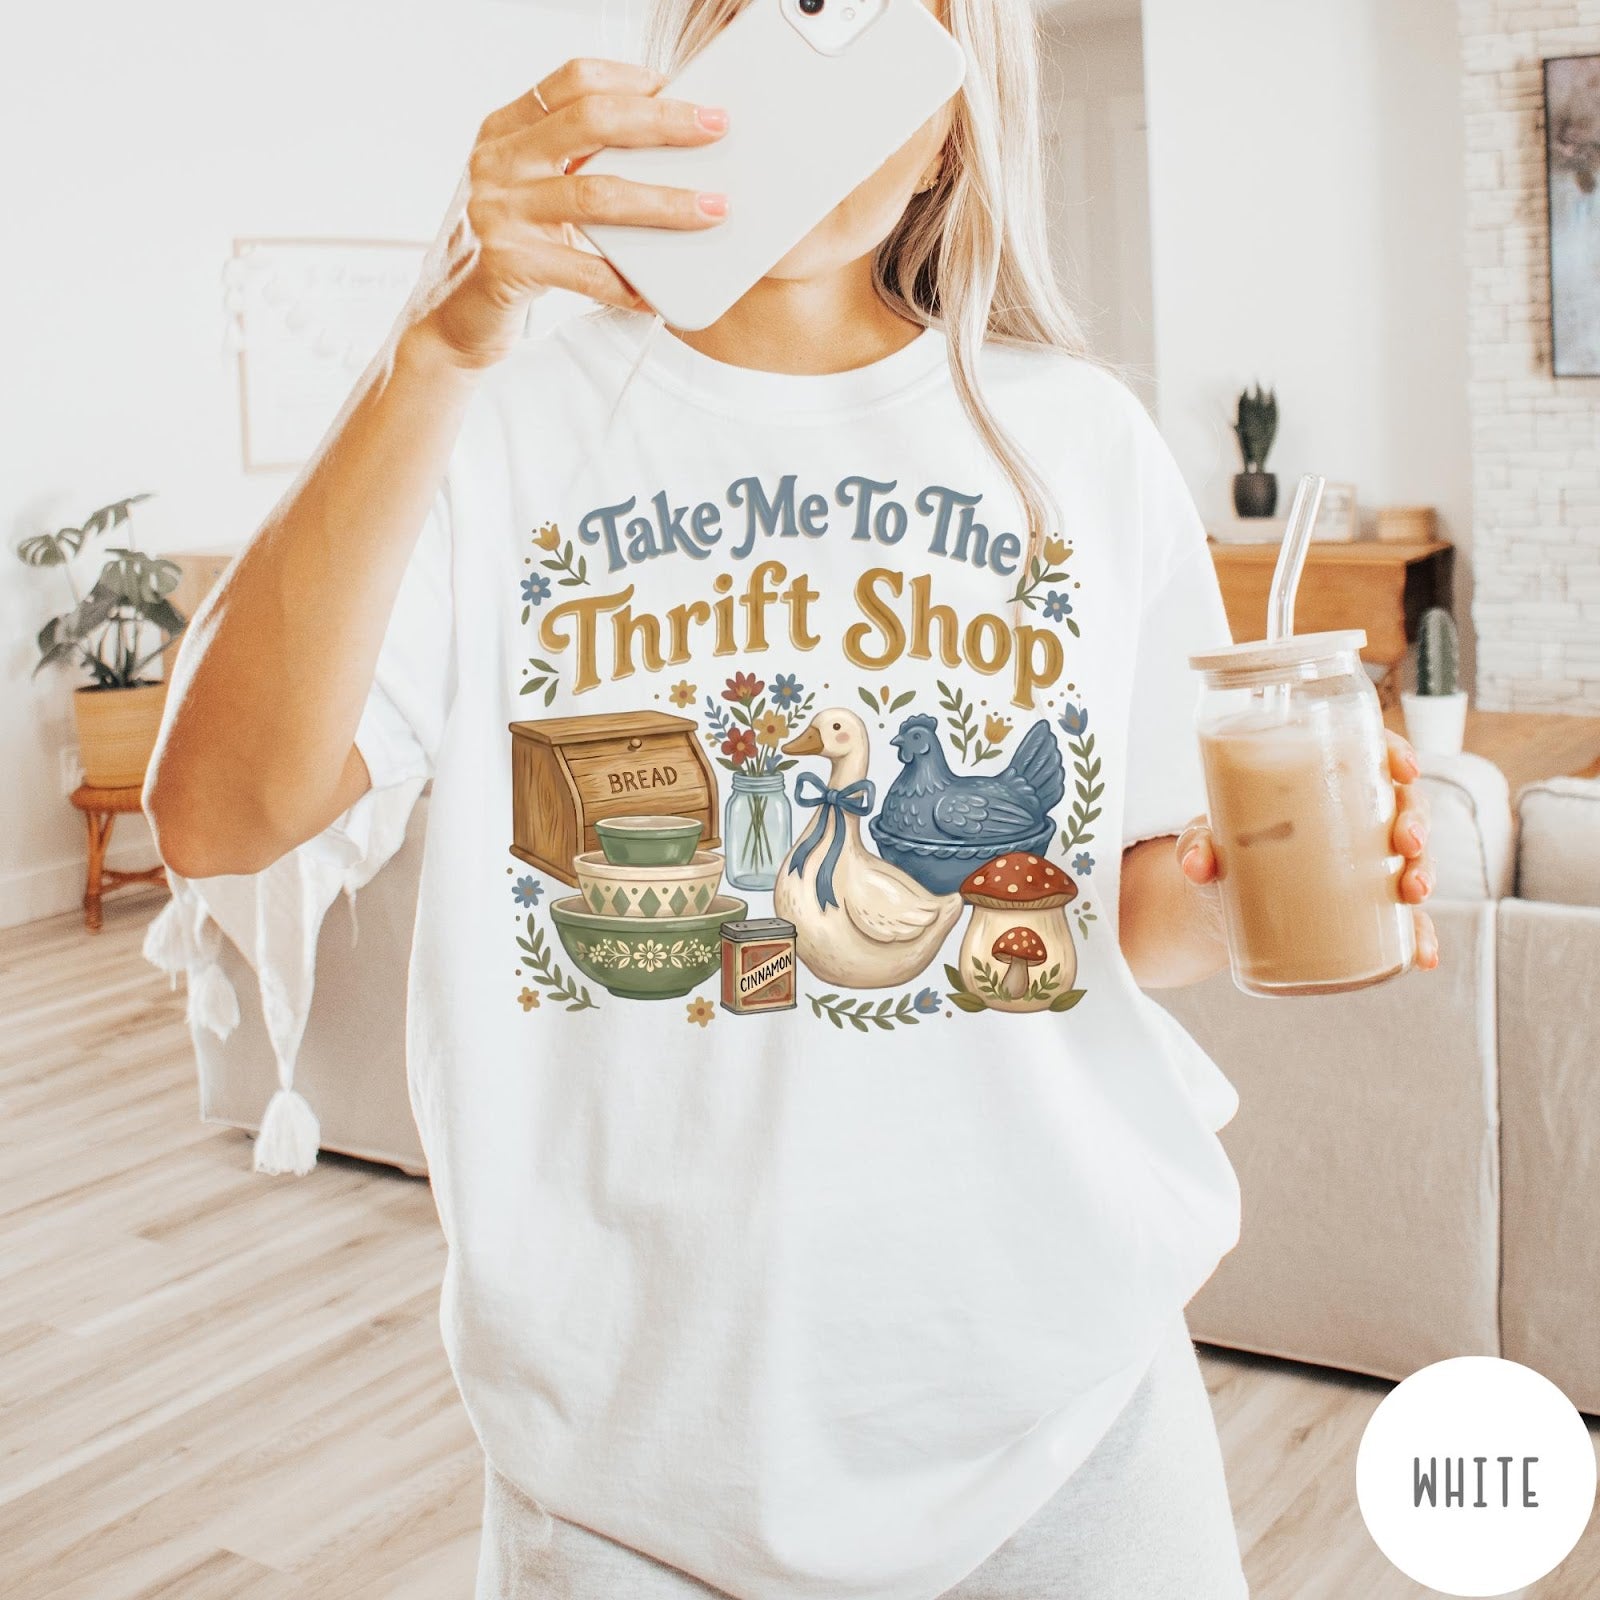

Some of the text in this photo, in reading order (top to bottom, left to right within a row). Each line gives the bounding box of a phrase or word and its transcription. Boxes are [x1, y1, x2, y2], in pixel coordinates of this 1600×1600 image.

[579, 475, 1021, 575] Take Me To The
[538, 560, 1064, 710] Thrift Shop
[607, 766, 678, 794] BREAD
[740, 953, 792, 993] CINNAMON
